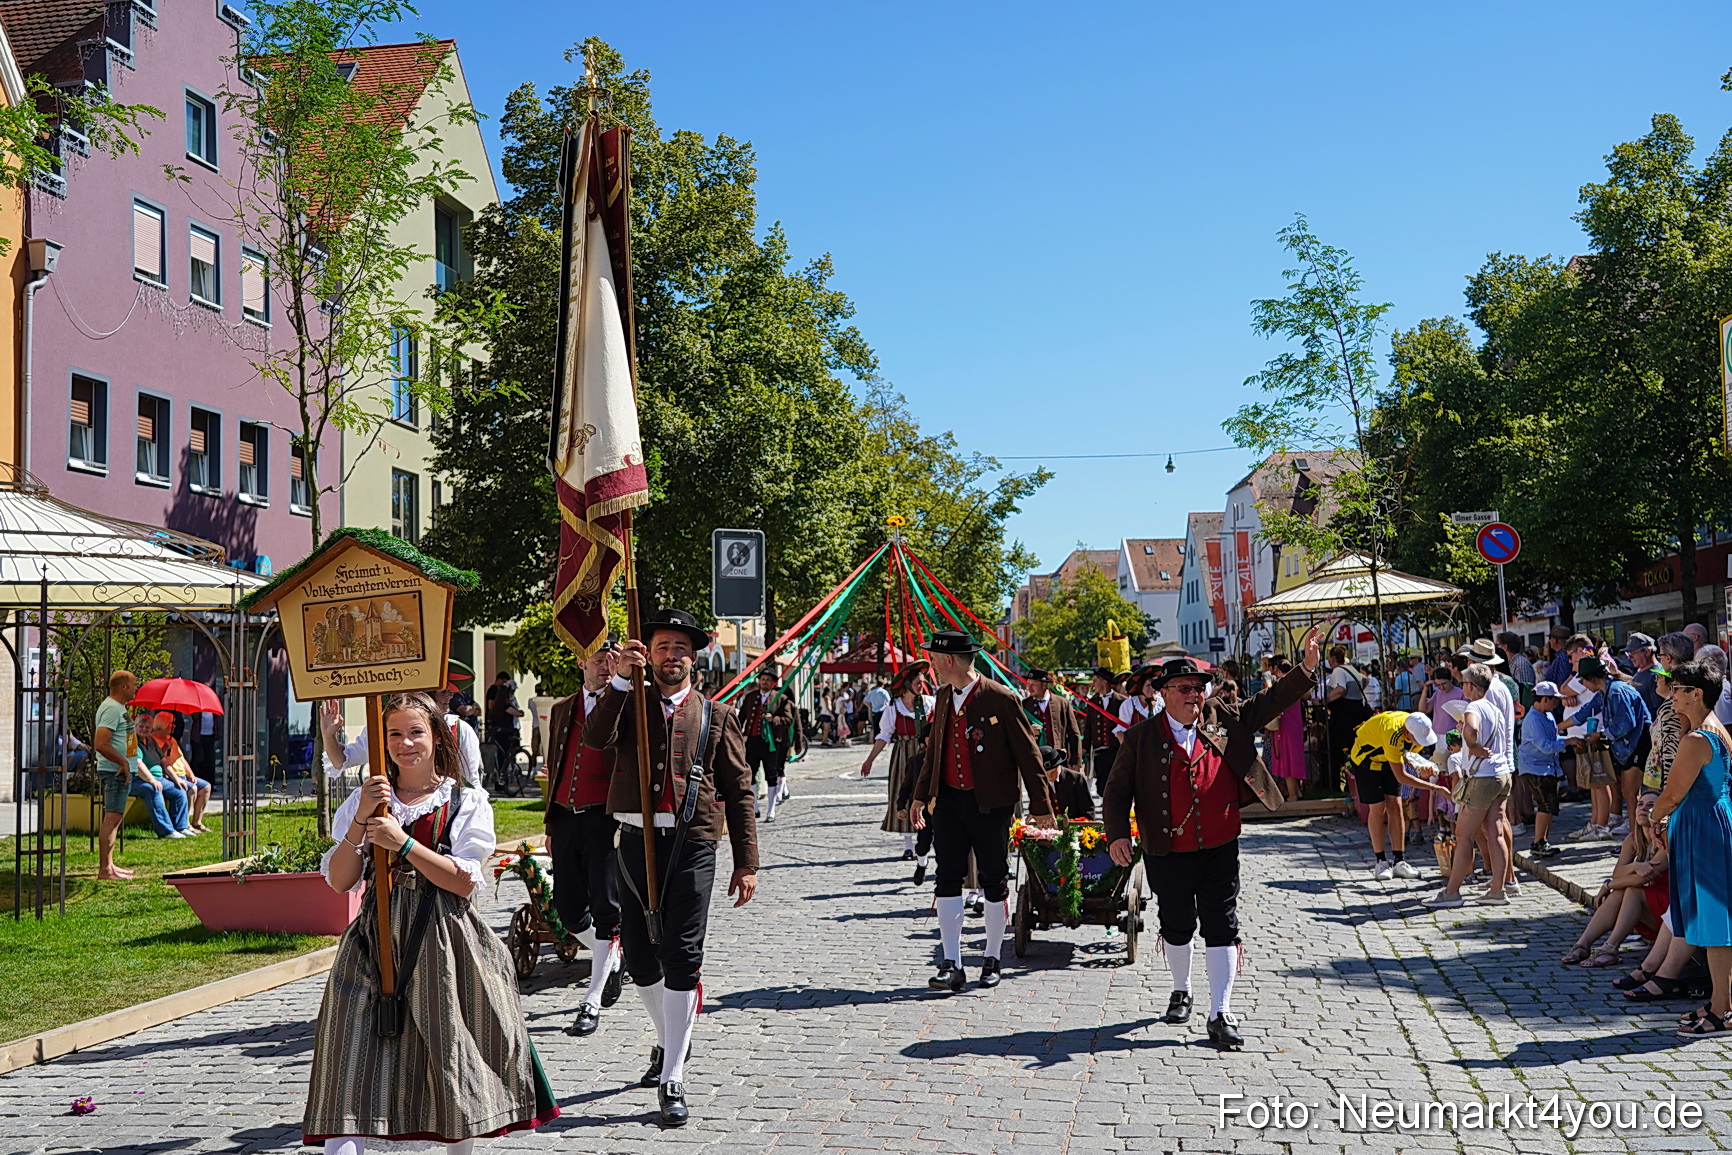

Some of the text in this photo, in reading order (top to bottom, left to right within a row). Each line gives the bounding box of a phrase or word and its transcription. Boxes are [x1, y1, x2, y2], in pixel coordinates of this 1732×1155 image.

[1455, 513, 1491, 522] Ulmer Gasse
[334, 563, 394, 584] Heimat u.
[729, 568, 748, 576] ZONE
[1237, 555, 1253, 593] SALE
[302, 575, 422, 599] Volkstrachtenverein
[329, 668, 404, 688] Sindlbach
